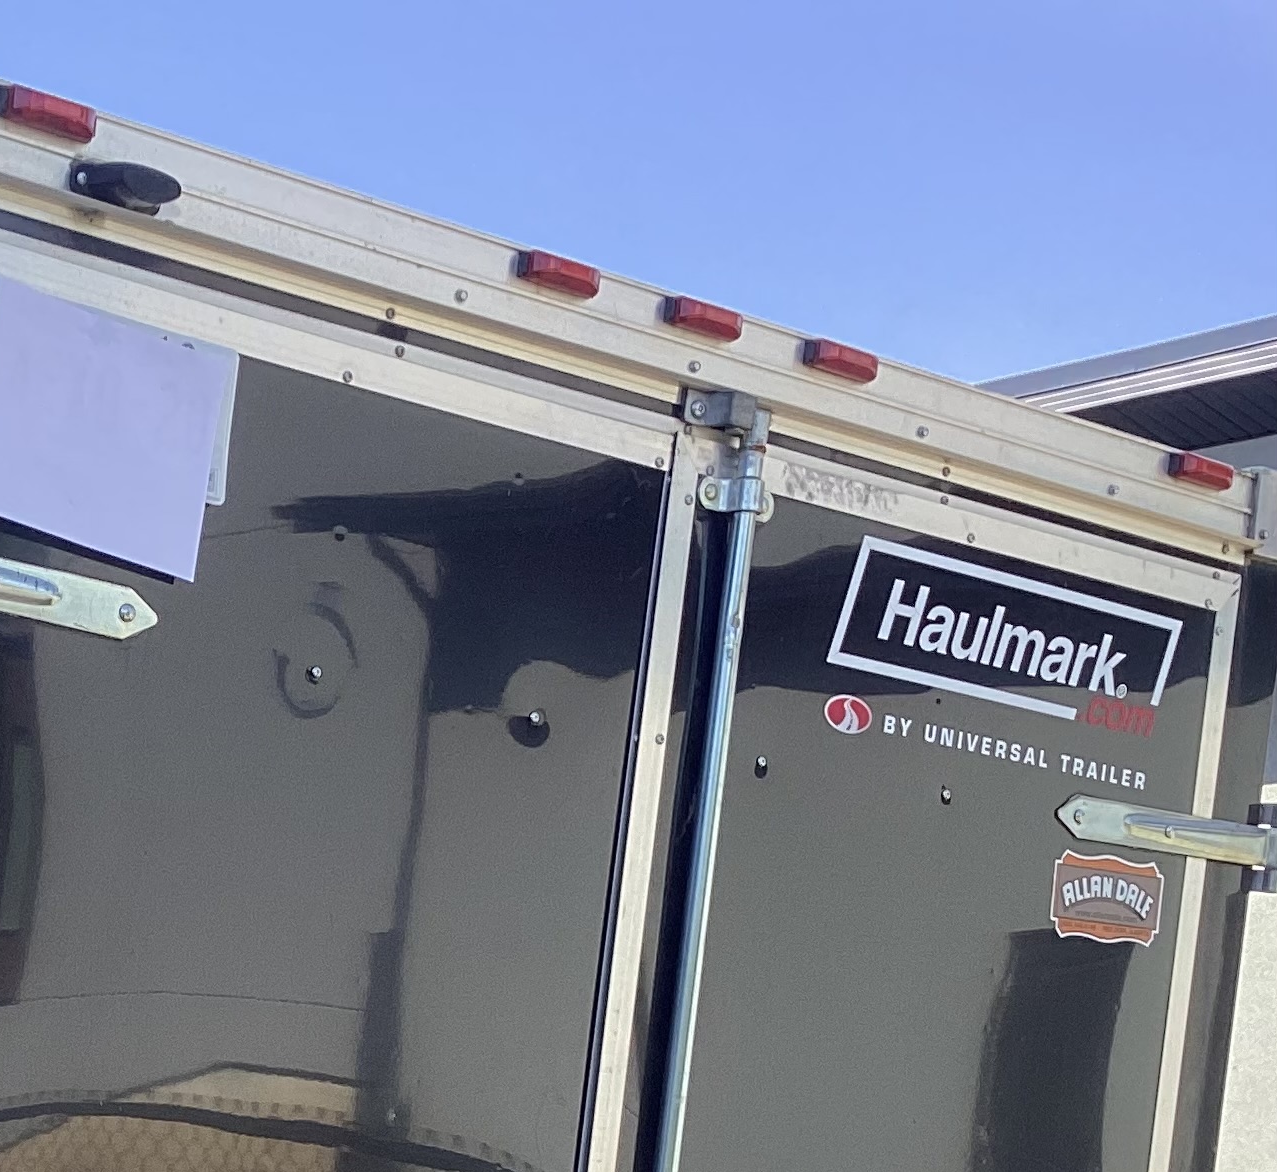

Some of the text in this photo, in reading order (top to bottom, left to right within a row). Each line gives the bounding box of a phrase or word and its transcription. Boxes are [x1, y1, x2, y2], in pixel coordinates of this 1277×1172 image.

[883, 715, 1146, 790] BY UNIVERSAL TRAILER
[1062, 875, 1154, 919] ALLAN DALE
